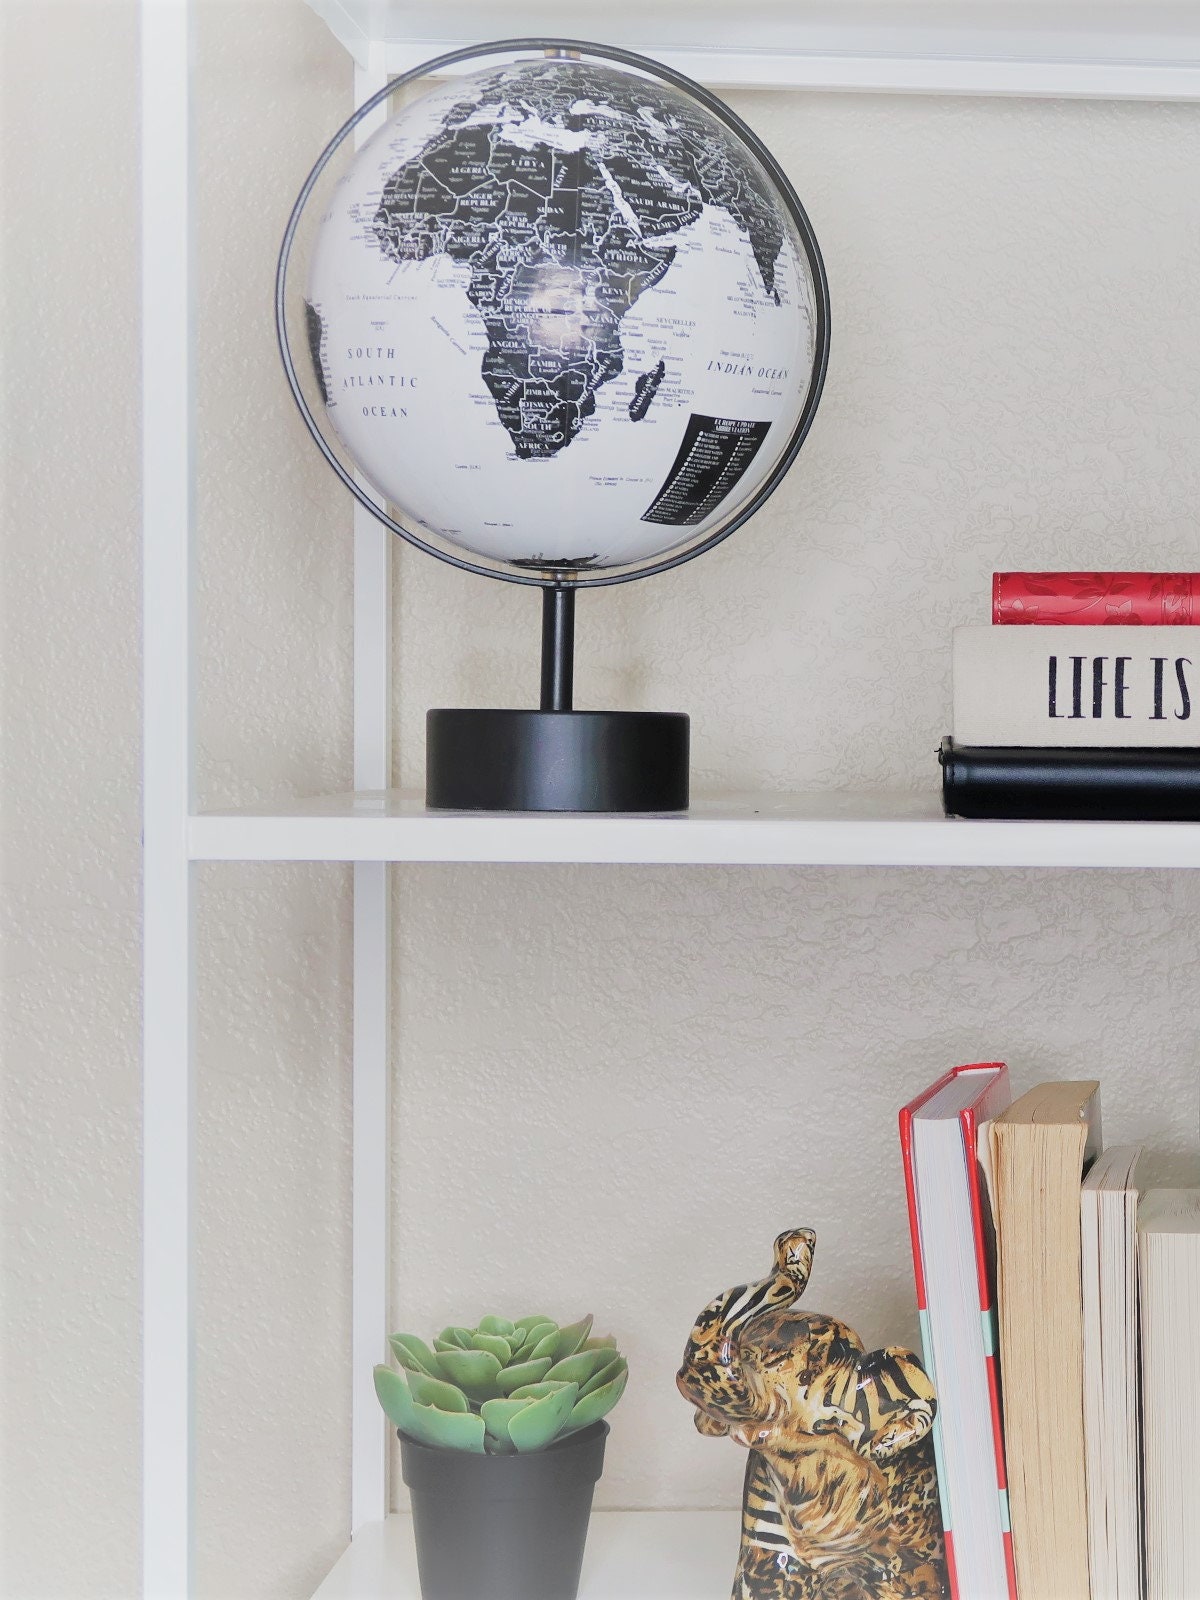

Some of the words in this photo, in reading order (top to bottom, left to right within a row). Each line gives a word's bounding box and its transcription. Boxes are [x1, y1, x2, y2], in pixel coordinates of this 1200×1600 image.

[650, 144, 684, 158] IRAN
[511, 159, 545, 168] LIBYA
[629, 197, 654, 207] SAUDI
[657, 200, 686, 212] ARABIA
[656, 317, 696, 326] SEYCHELLES
[490, 340, 526, 348] ANGOLA
[347, 348, 395, 359] SOUTH
[530, 360, 562, 369] ZAMBIA
[707, 360, 752, 376] INDIAN
[757, 367, 790, 380] OCEAN
[343, 375, 418, 389] ATLANTIC
[362, 406, 409, 418] OCEAN
[518, 442, 550, 450] AFRICA
[1048, 655, 1132, 719] LIFE
[1148, 657, 1193, 721] IS
